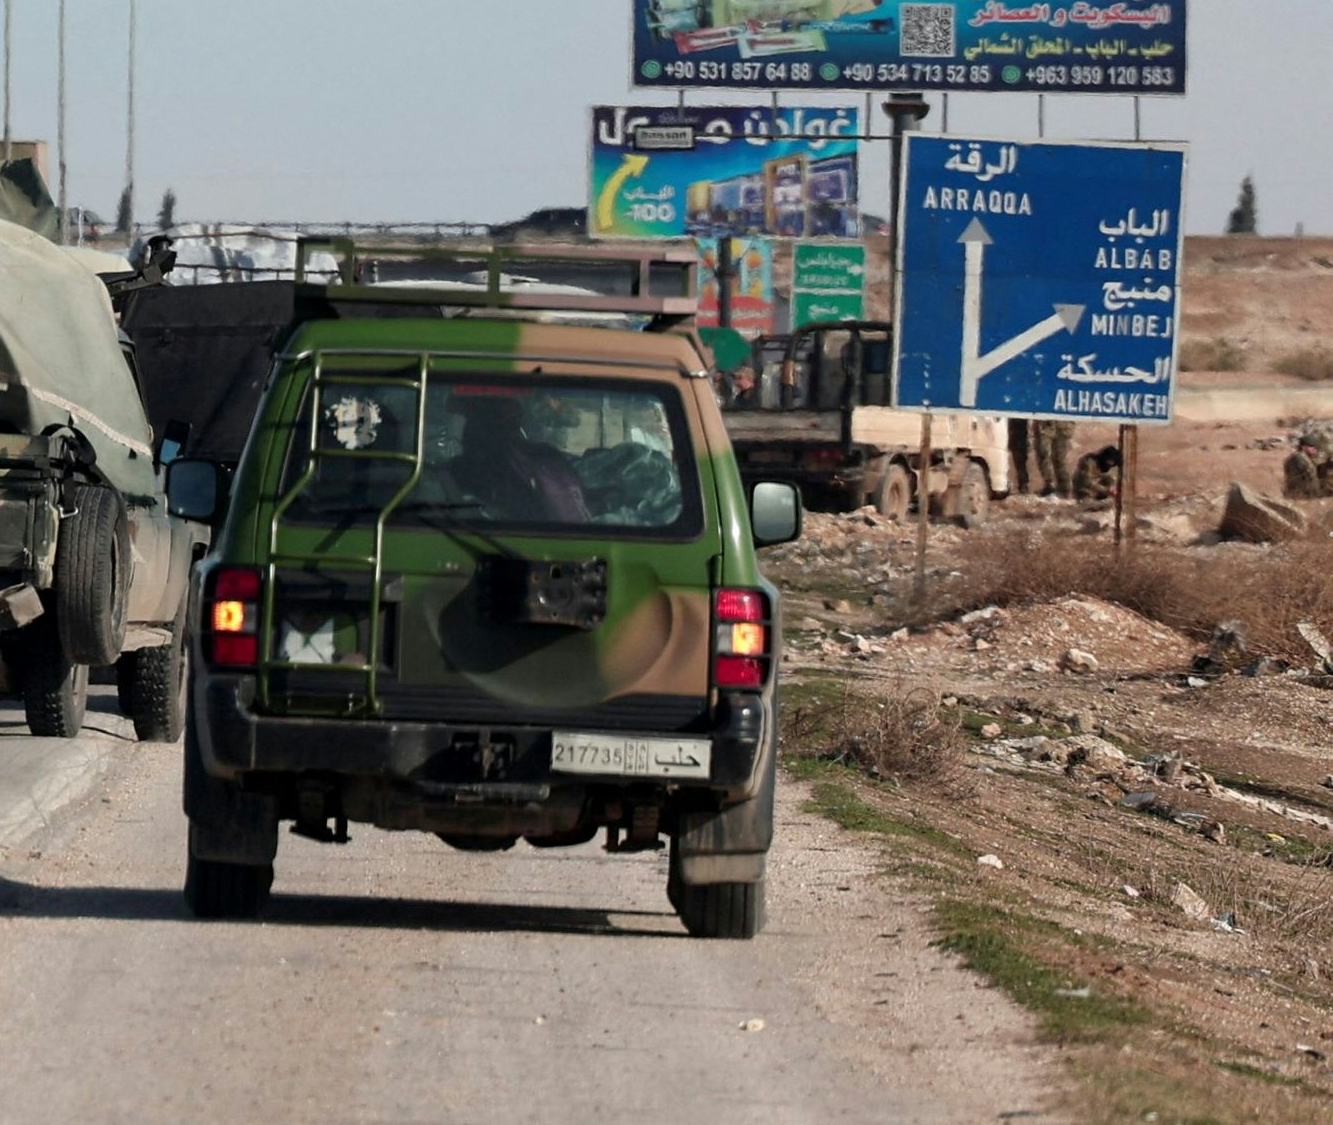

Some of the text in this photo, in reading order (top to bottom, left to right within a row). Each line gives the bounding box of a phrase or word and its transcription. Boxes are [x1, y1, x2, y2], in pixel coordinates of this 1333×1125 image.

[664, 61, 693, 79] +90
[699, 61, 726, 79] 531
[765, 62, 785, 80] 64
[843, 63, 874, 82] +90
[944, 142, 1018, 181] الرقة
[923, 186, 1031, 215] ARRAQQA
[1099, 208, 1169, 243] الباب
[1094, 248, 1171, 270] ALBAB
[1102, 277, 1173, 310] منبج
[1091, 314, 1173, 338] MINBEJ
[1057, 353, 1171, 384] الحسكة
[1054, 389, 1168, 416] ALHASAKEH
